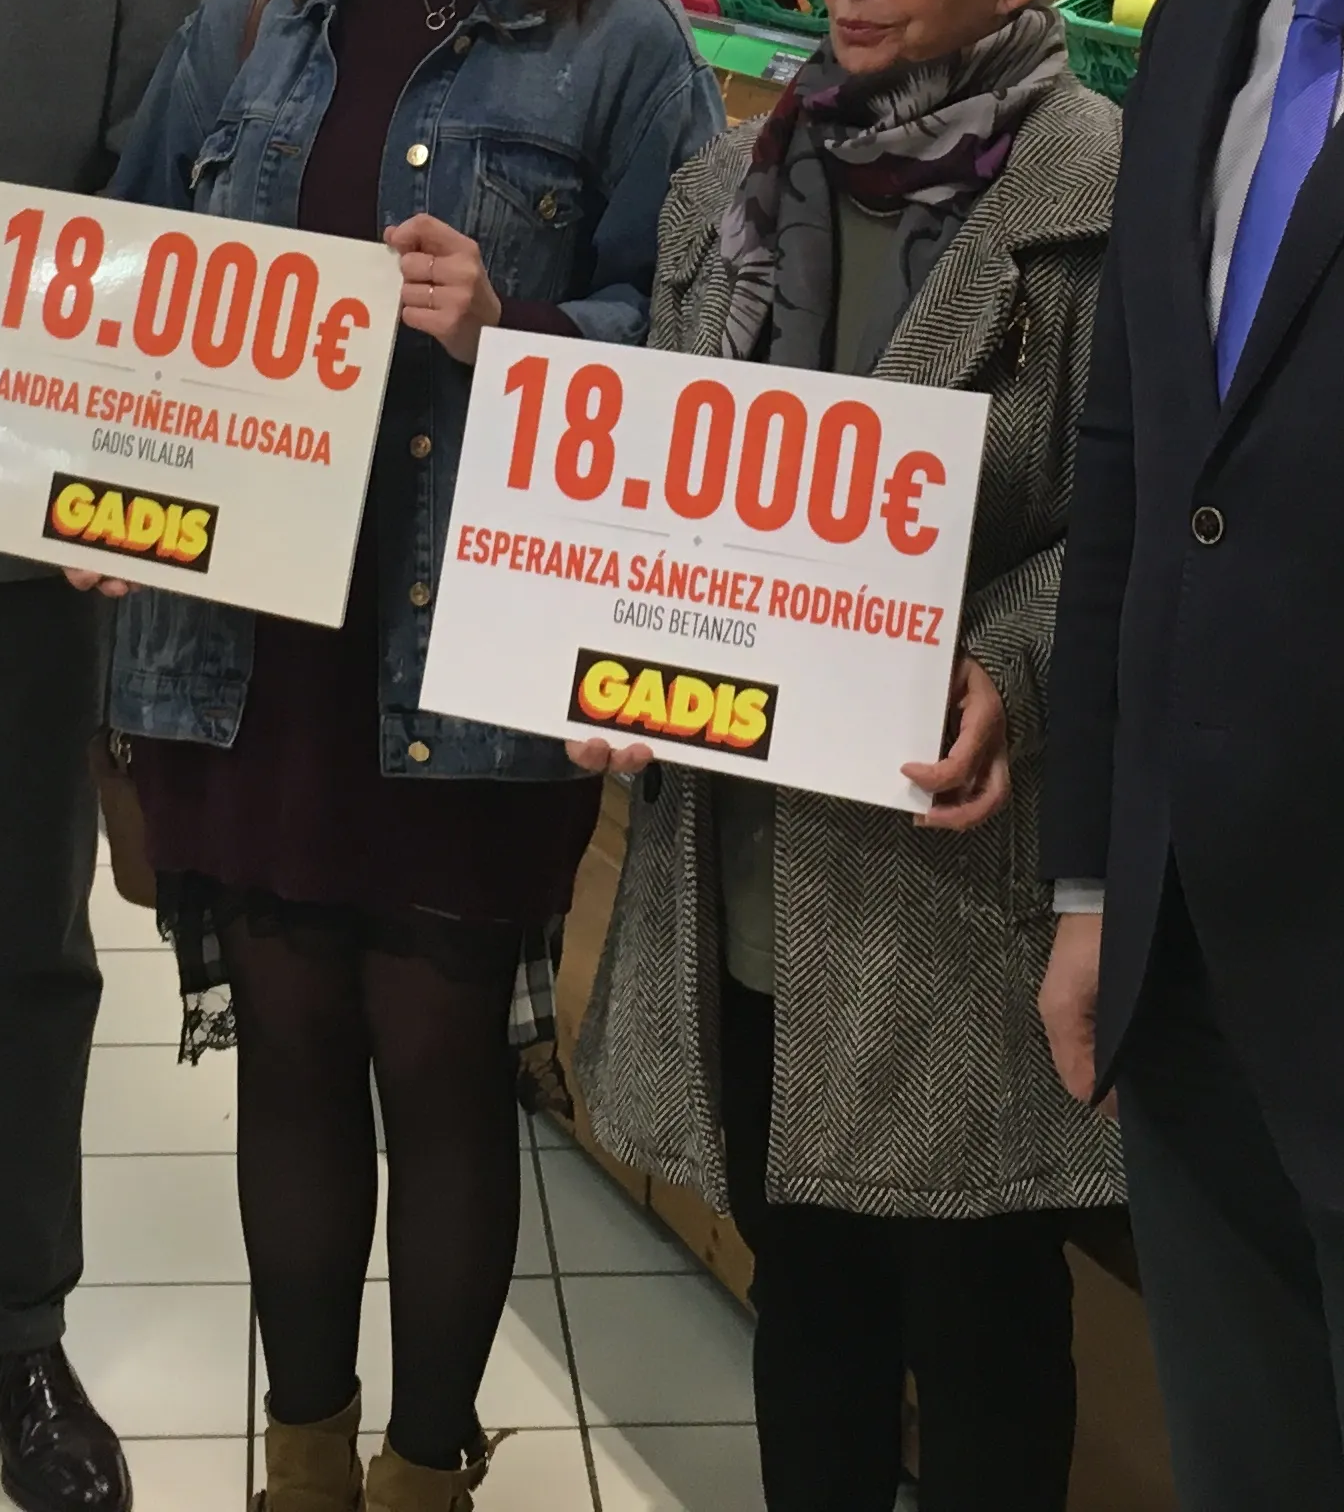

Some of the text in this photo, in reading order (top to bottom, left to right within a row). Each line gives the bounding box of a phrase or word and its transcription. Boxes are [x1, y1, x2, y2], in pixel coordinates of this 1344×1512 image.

[1, 207, 371, 392] 18.000€
[85, 385, 219, 444] ESPIÑEIRA
[225, 415, 332, 466] LOSADA
[91, 427, 195, 470] GADIS VILALBA
[503, 354, 947, 557] 18.000€
[51, 482, 212, 564] GADIS
[457, 524, 945, 646] ESPERANZA SÁNCHEZ RODRÍGUEZ
[612, 597, 757, 649] GADIS BETANZOS
[577, 659, 771, 749] GADIS
